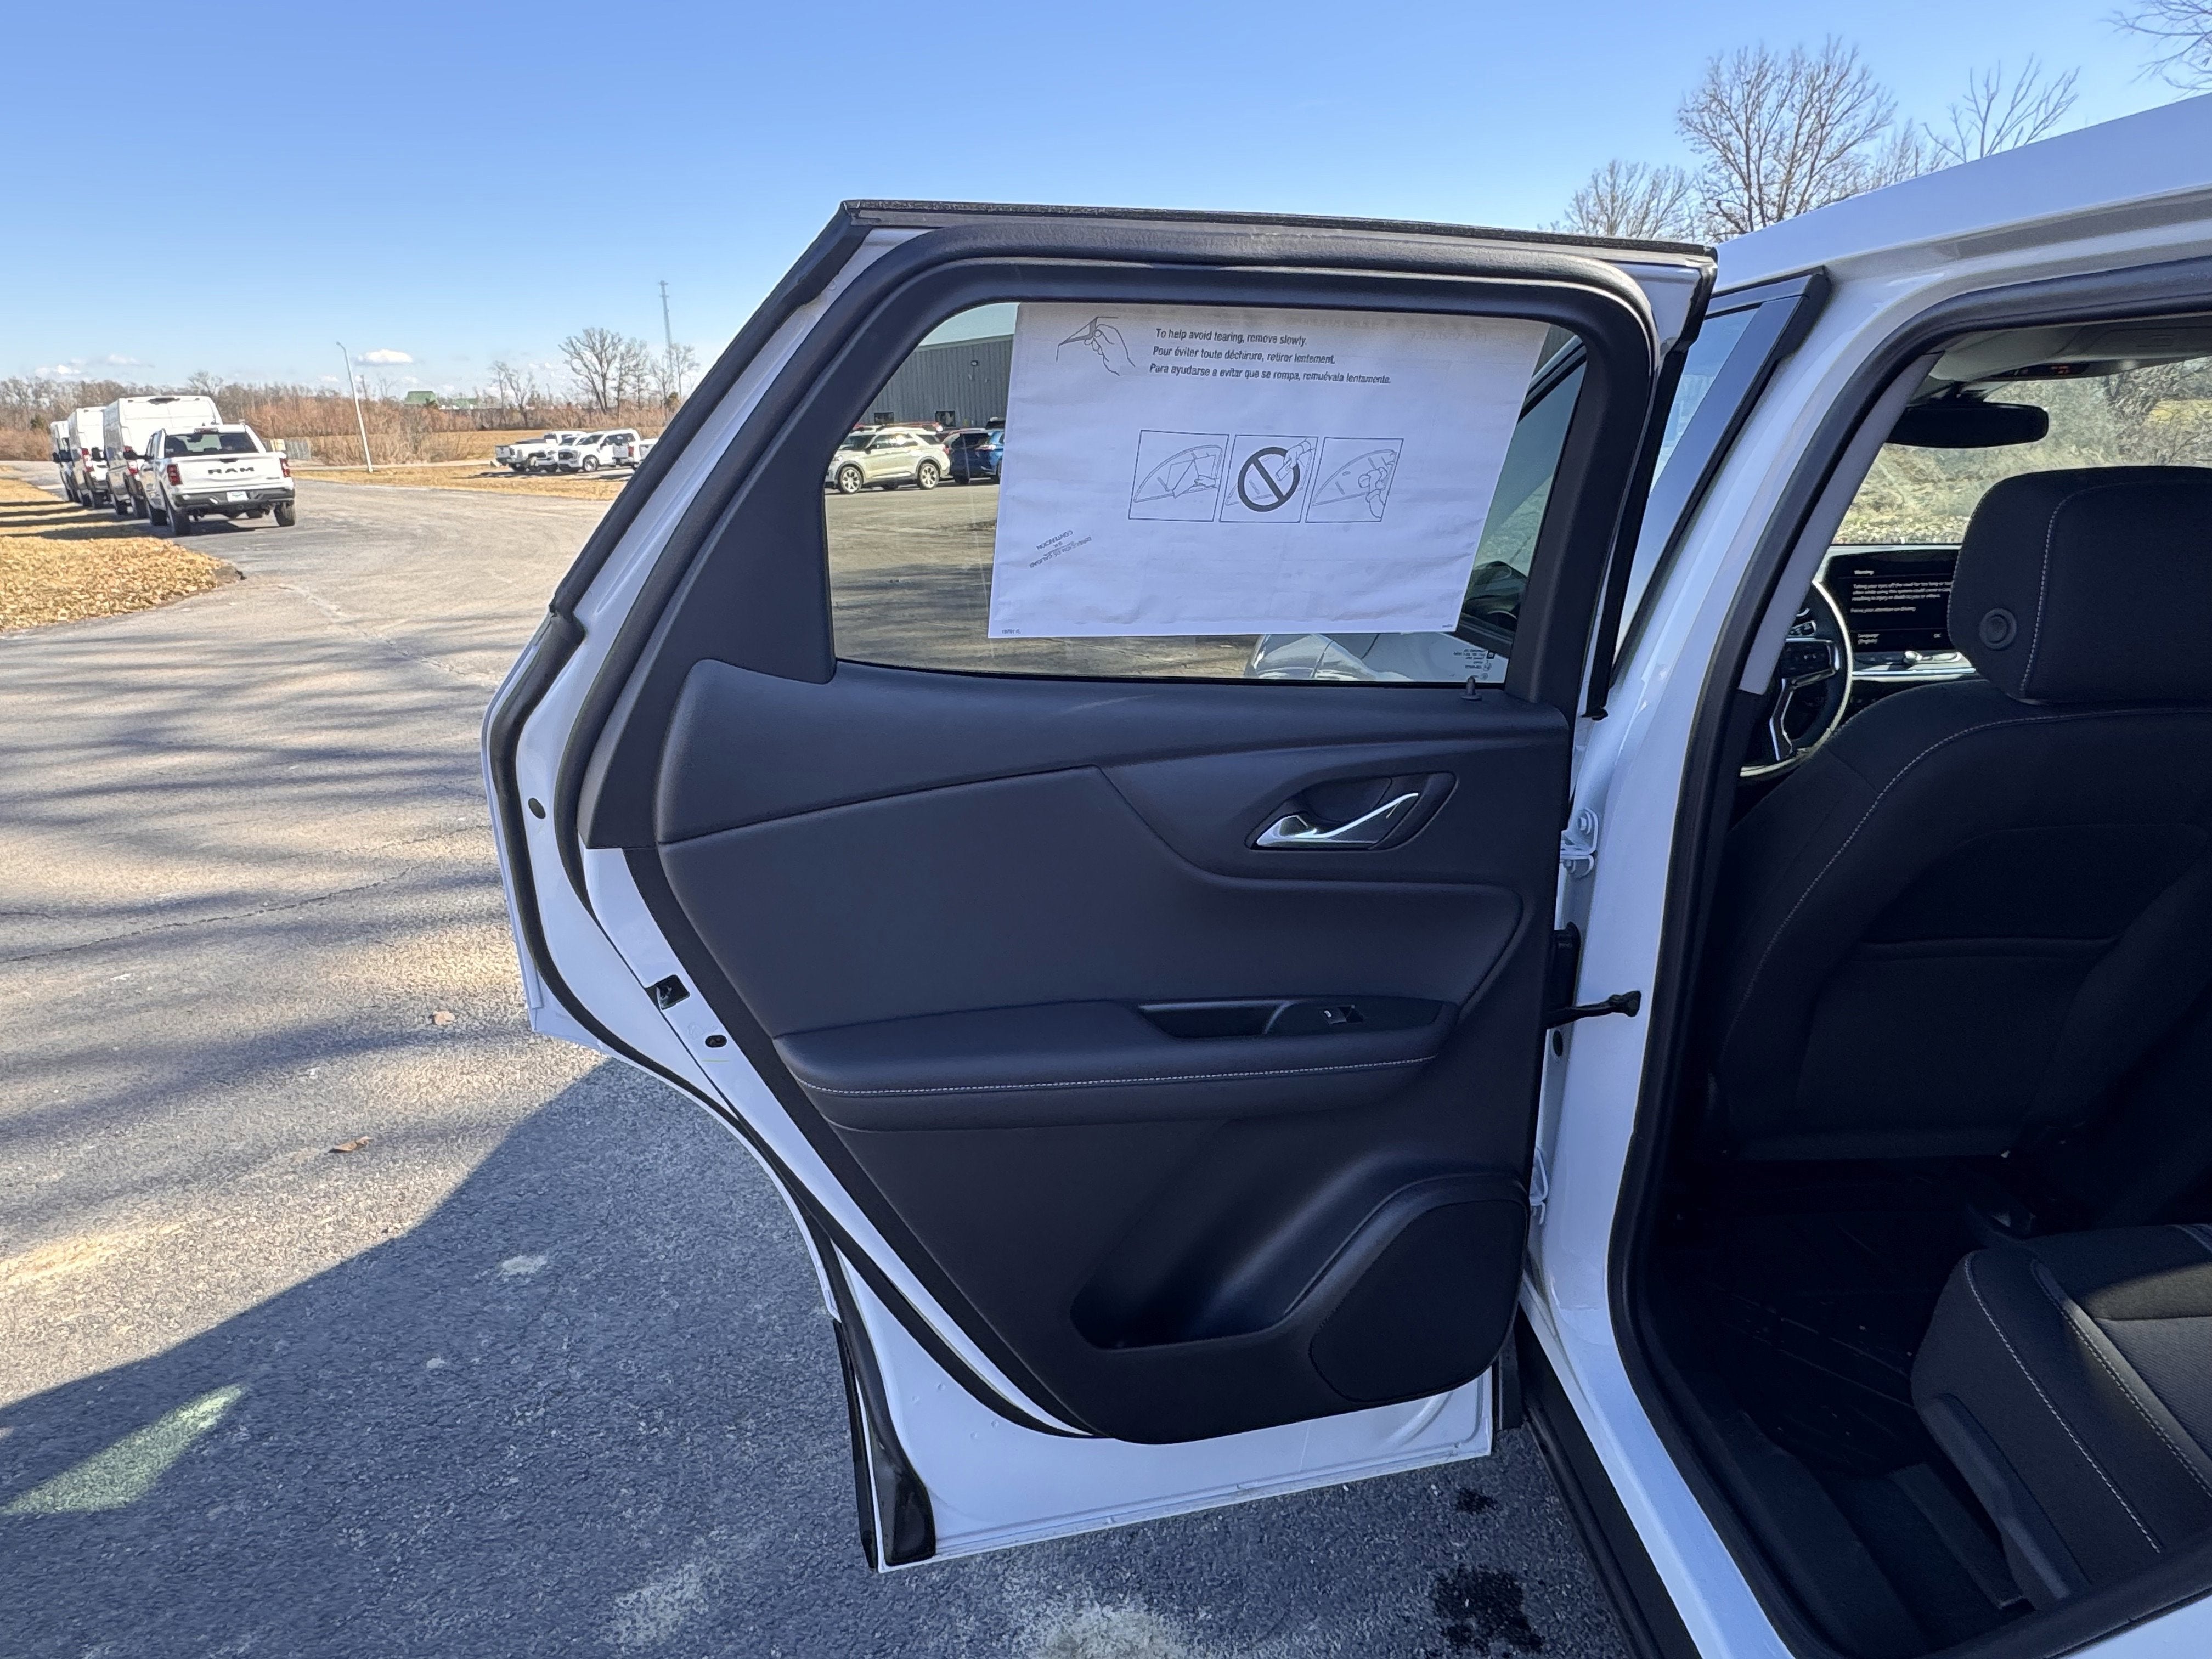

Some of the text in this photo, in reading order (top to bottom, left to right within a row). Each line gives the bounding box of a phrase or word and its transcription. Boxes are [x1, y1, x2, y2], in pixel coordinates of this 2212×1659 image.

[1156, 328, 1307, 347] To help avoid tearing, remove slowly.
[1153, 346, 1172, 356] Pour
[1175, 347, 1199, 357] éviter
[1201, 348, 1222, 359] toute
[1267, 353, 1293, 363] retirer
[1149, 363, 1169, 373] Para
[1171, 365, 1210, 376] ayudarse
[1220, 368, 1243, 377] evitar
[1245, 370, 1259, 379] que
[1273, 371, 1300, 382] rompa,
[1302, 371, 1344, 382] remuévala
